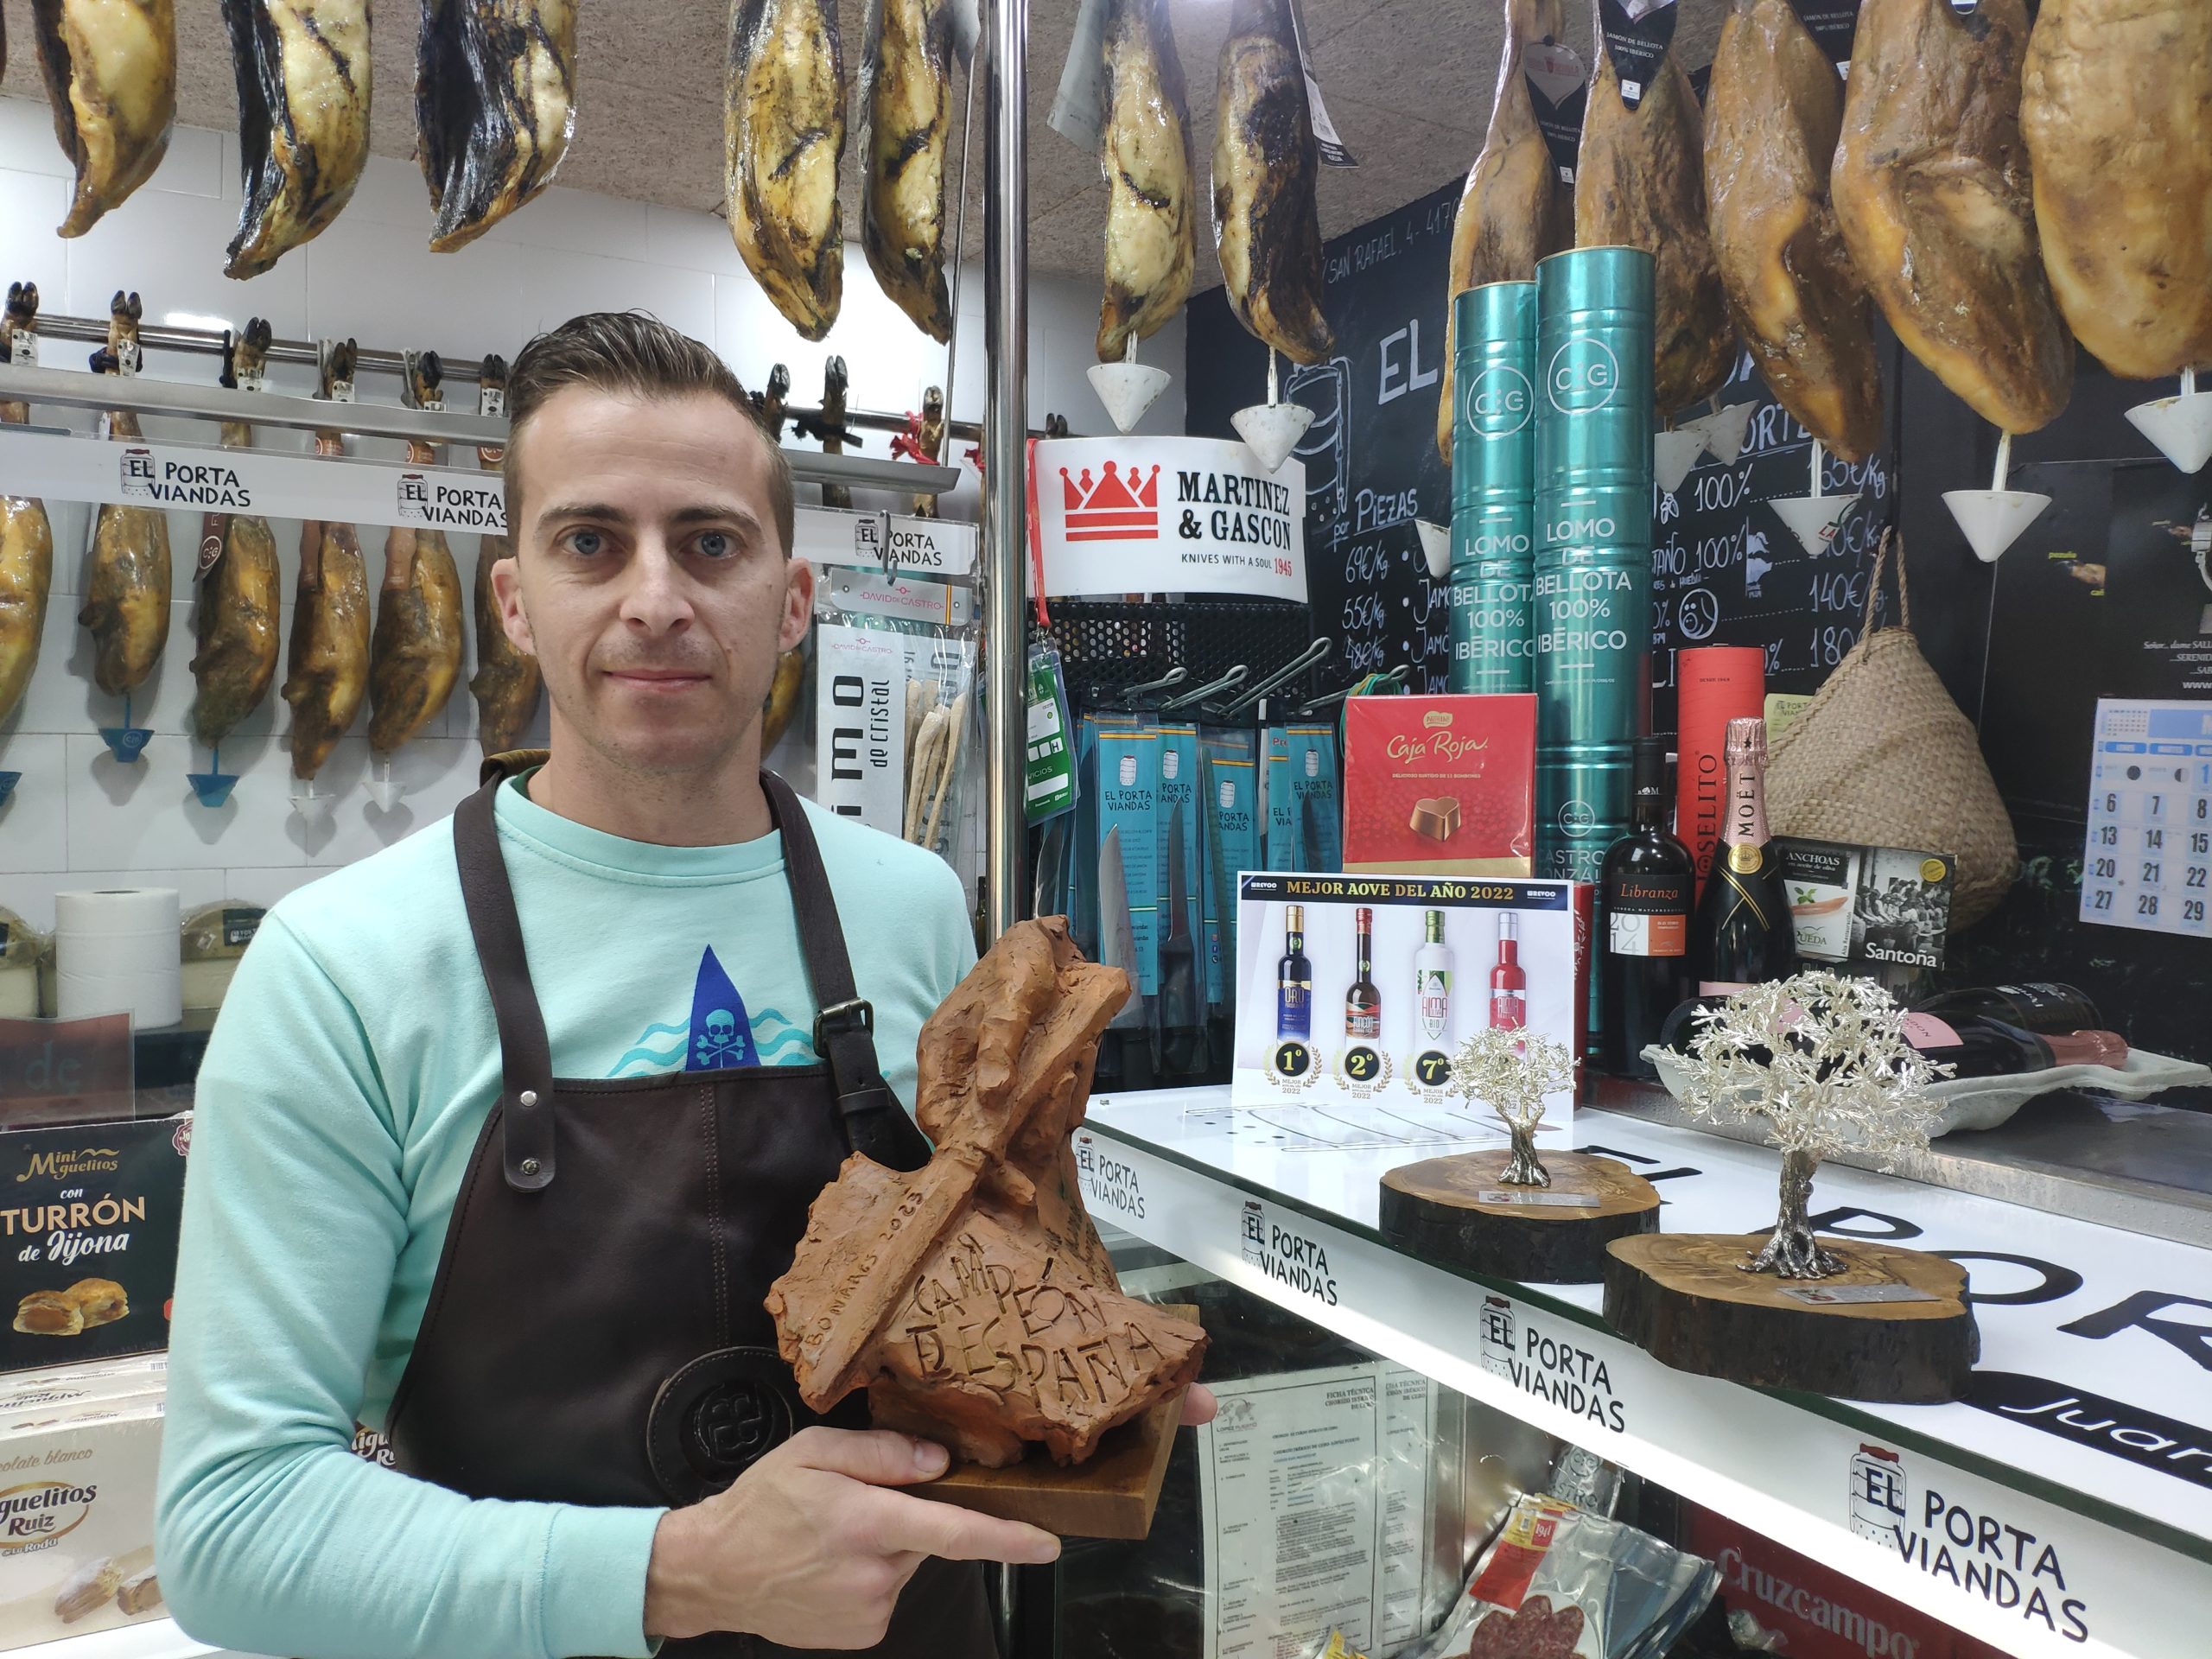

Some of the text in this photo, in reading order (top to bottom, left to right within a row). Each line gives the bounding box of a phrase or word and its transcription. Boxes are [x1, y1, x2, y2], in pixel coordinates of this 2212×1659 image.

[1379, 318, 1439, 404] EL
[130, 460, 240, 488] EL PORTA
[148, 483, 251, 507] VIANDAS
[406, 484, 502, 511] EL PORTA
[1177, 471, 1290, 517] MARTINEZ
[1694, 462, 1752, 512] 100%
[861, 529, 878, 543] EL
[1179, 509, 1291, 551] & GASCON
[1547, 518, 1615, 543] LOMO
[874, 547, 943, 566] VANDAS
[1465, 535, 1529, 556] LOMO
[1561, 545, 1596, 566] DE
[1694, 524, 1745, 572] 100%
[1181, 553, 1219, 564] KNIVES
[1222, 555, 1245, 566] WITH
[1248, 557, 1254, 566] A
[1255, 557, 1272, 569] SOUL
[1480, 561, 1510, 578] DE
[1536, 571, 1631, 596] BELLOTA
[862, 592, 893, 602] DAVID
[901, 597, 942, 610] CASTRO
[1549, 598, 1610, 620] 100%
[1467, 609, 1524, 629] 100%
[1387, 734, 1426, 764] Caja
[1105, 790, 1153, 801] EL PORTA
[1162, 783, 1192, 793] PORTA
[1294, 781, 1332, 791] EL PORTA
[1108, 800, 1151, 810] VIANDAS
[1219, 812, 1249, 822] PORTA
[1274, 808, 1284, 817] EL
[1737, 773, 1756, 836] MOËT
[2106, 793, 2207, 819] 6 7 8
[2101, 826, 2209, 854] 13 14 15
[1786, 852, 1840, 866] ANCHOAS
[2096, 858, 2207, 887] 20 21 22
[1287, 880, 1515, 900] MEJOR AOVE DEL AÑO 2022
[1620, 883, 1679, 900] Libranza
[2094, 890, 2204, 921] 27 28 29
[1865, 941, 1937, 968] Santoña
[1422, 997, 1448, 1018] ALMA
[1429, 1019, 1440, 1028] BIO
[1080, 1148, 1140, 1193] EL PORTA
[60, 1188, 83, 1199] con
[1090, 1177, 1146, 1219] VIANDAS
[0, 1192, 146, 1236] TURRÓN
[18, 1230, 130, 1266] de Jijona
[1248, 1216, 1329, 1276] EL PORTA
[1260, 1251, 1338, 1306] VIANDAS
[1490, 1314, 1612, 1395] EL PORTA
[1508, 1357, 1625, 1433] VIANDAS
[44, 1449, 93, 1465] blanco
[8, 1514, 56, 1536] Ruiz
[1866, 1467, 2067, 1592] EL PORTA
[24, 1537, 58, 1554] Roda
[1893, 1525, 2089, 1644] VIANDAS
[1718, 1548, 1916, 1659] Cruzcampo
